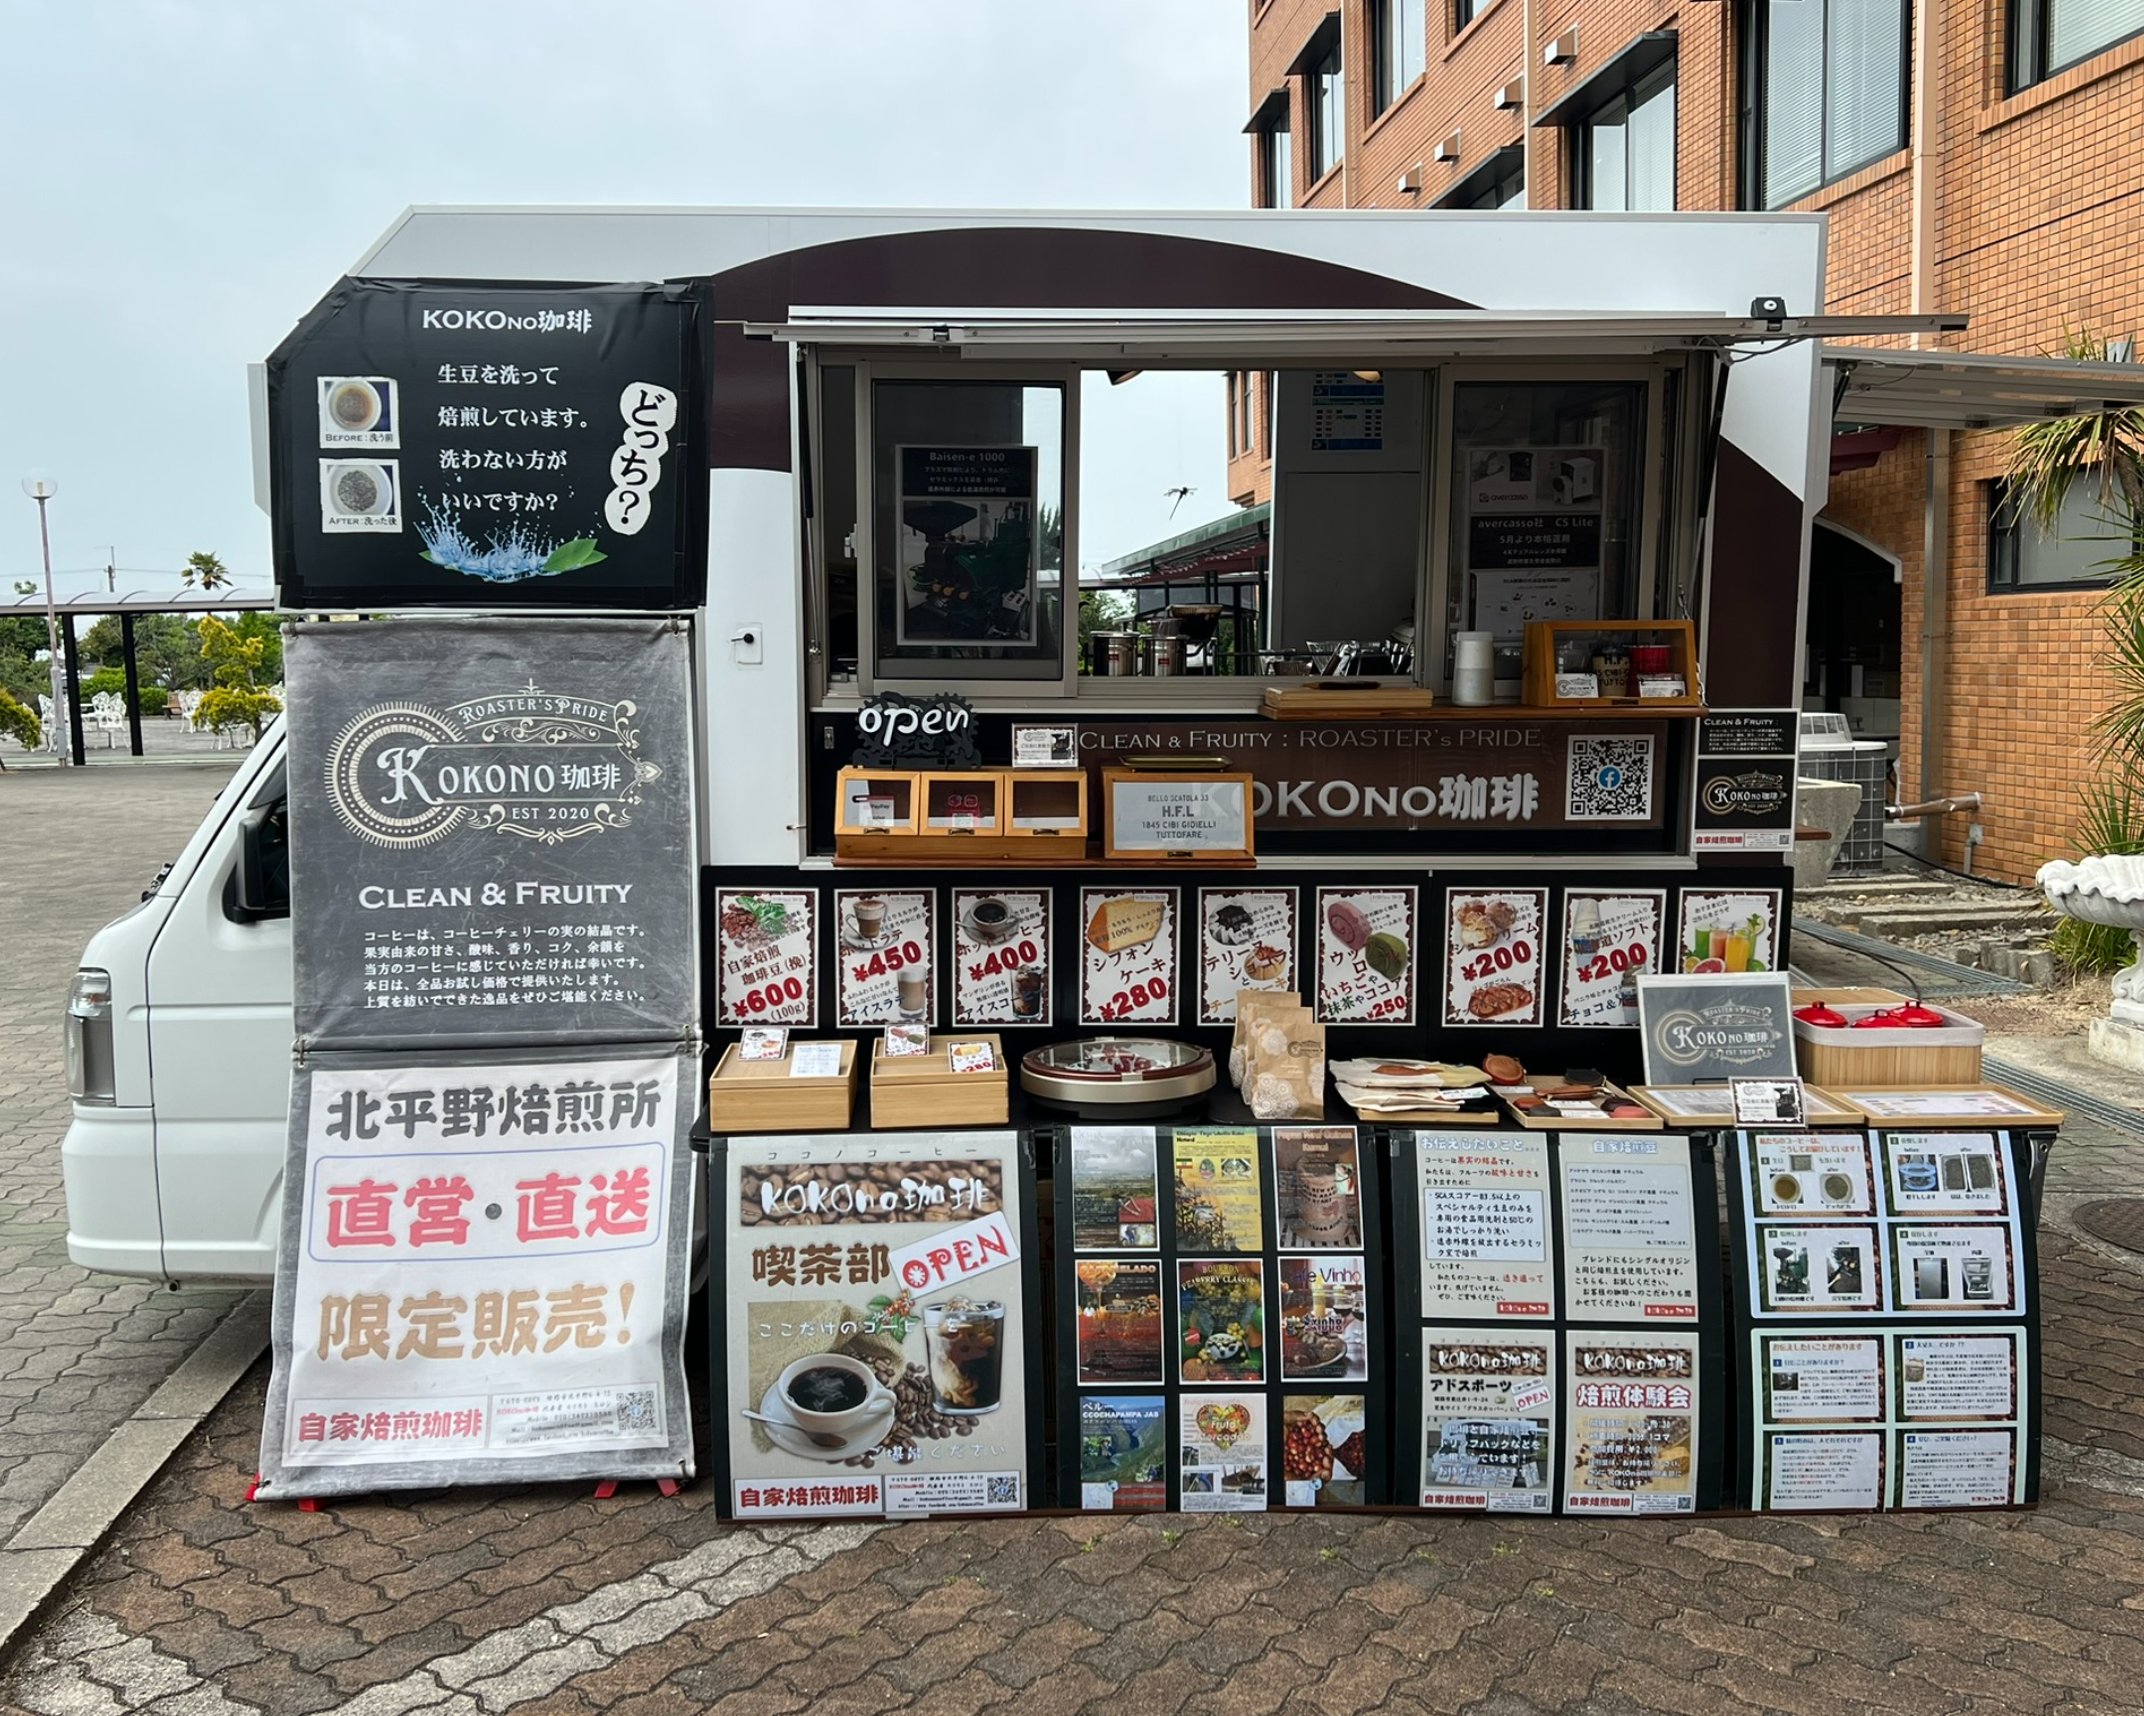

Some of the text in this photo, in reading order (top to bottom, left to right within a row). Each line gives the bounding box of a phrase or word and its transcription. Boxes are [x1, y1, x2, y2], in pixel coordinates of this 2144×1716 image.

[437, 364, 559, 385] 生豆を洗って
[438, 406, 589, 428] 焙煎しています。
[439, 450, 567, 471] 洗わない方が
[930, 451, 1005, 462] Baisen-e 1000
[1555, 517, 1569, 527] CS
[1572, 517, 1594, 527] Lite
[458, 697, 608, 725] ROASTER'S PRIDE
[1704, 718, 1733, 726] CLEAN
[1743, 717, 1774, 726] FRUITY
[858, 706, 969, 747] open
[1080, 731, 1160, 749] CLEAN
[1169, 736, 1181, 748] &
[1189, 730, 1270, 749] FRUITY
[1458, 728, 1542, 748] PRIDE
[376, 745, 622, 805] KOKONO 珈琲
[1147, 794, 1198, 802] BELLO SCATOLA
[512, 806, 589, 820] EST 2020
[1142, 820, 1217, 830] 1845 CIBI GIOIELLI
[1156, 831, 1203, 840] TUTTOFARE
[358, 881, 633, 909] CLEAN & FRUITY
[364, 925, 646, 942] コーヒーは、コーヒーチェリーの実の結晶です。
[364, 940, 625, 959] 果実由来の甘さ、酸味、香り、コク、余韻を
[727, 945, 782, 974] 自家焙煎
[1093, 941, 1154, 972] シフォン
[364, 957, 646, 975] 当方のコーヒーに感じていただければ幸いです。
[851, 940, 922, 982] ¥450
[968, 939, 1037, 982] ¥400
[1119, 957, 1167, 985] ケーキ
[1460, 939, 1532, 982] ¥200
[1575, 942, 1648, 984] ¥200
[364, 973, 621, 992] 本日は、全品お試し価格で提供いたします。
[1241, 976, 1251, 986] と
[731, 976, 803, 1018] ¥600
[1097, 976, 1168, 1022] ¥280
[1327, 976, 1402, 1017] 抹茶やココア
[1366, 994, 1407, 1020] ¥250
[771, 1001, 806, 1022] (100g)
[848, 994, 905, 1021] アイスラテ
[325, 1079, 662, 1142] 北平野焙煎所
[767, 1146, 977, 1160] ココノコーヒー
[1593, 1139, 1658, 1154] 自家焙煎豆
[1425, 1155, 1515, 1165] コーヒーは果実の結晶です。
[325, 1166, 651, 1248] 直営・直送
[751, 1242, 891, 1287] 喫茶部
[902, 1225, 1011, 1289] OPEN
[1581, 1255, 1691, 1265] ブレンドにもシングルオリジン
[1318, 1267, 1362, 1284] Vinho
[316, 1281, 636, 1363] 限定販売!
[759, 1320, 960, 1338] ここだけのコーヒーを
[1430, 1379, 1512, 1393] アドスポーツ
[1576, 1383, 1691, 1409] 焙煎体験会
[1082, 1402, 1114, 1412] ペルー
[1517, 1390, 1549, 1409] OPEN
[298, 1407, 484, 1442] 自家焙煎珈琲
[1082, 1410, 1159, 1419] CCOCHAPAMPA JAS
[867, 1443, 1006, 1462] ご堪能ください
[739, 1484, 879, 1508] 自家焙煎珈琲
[1424, 1494, 1486, 1504] 自家焙煎珈琲
[1569, 1497, 1631, 1507] 自家焙煎珈琲
